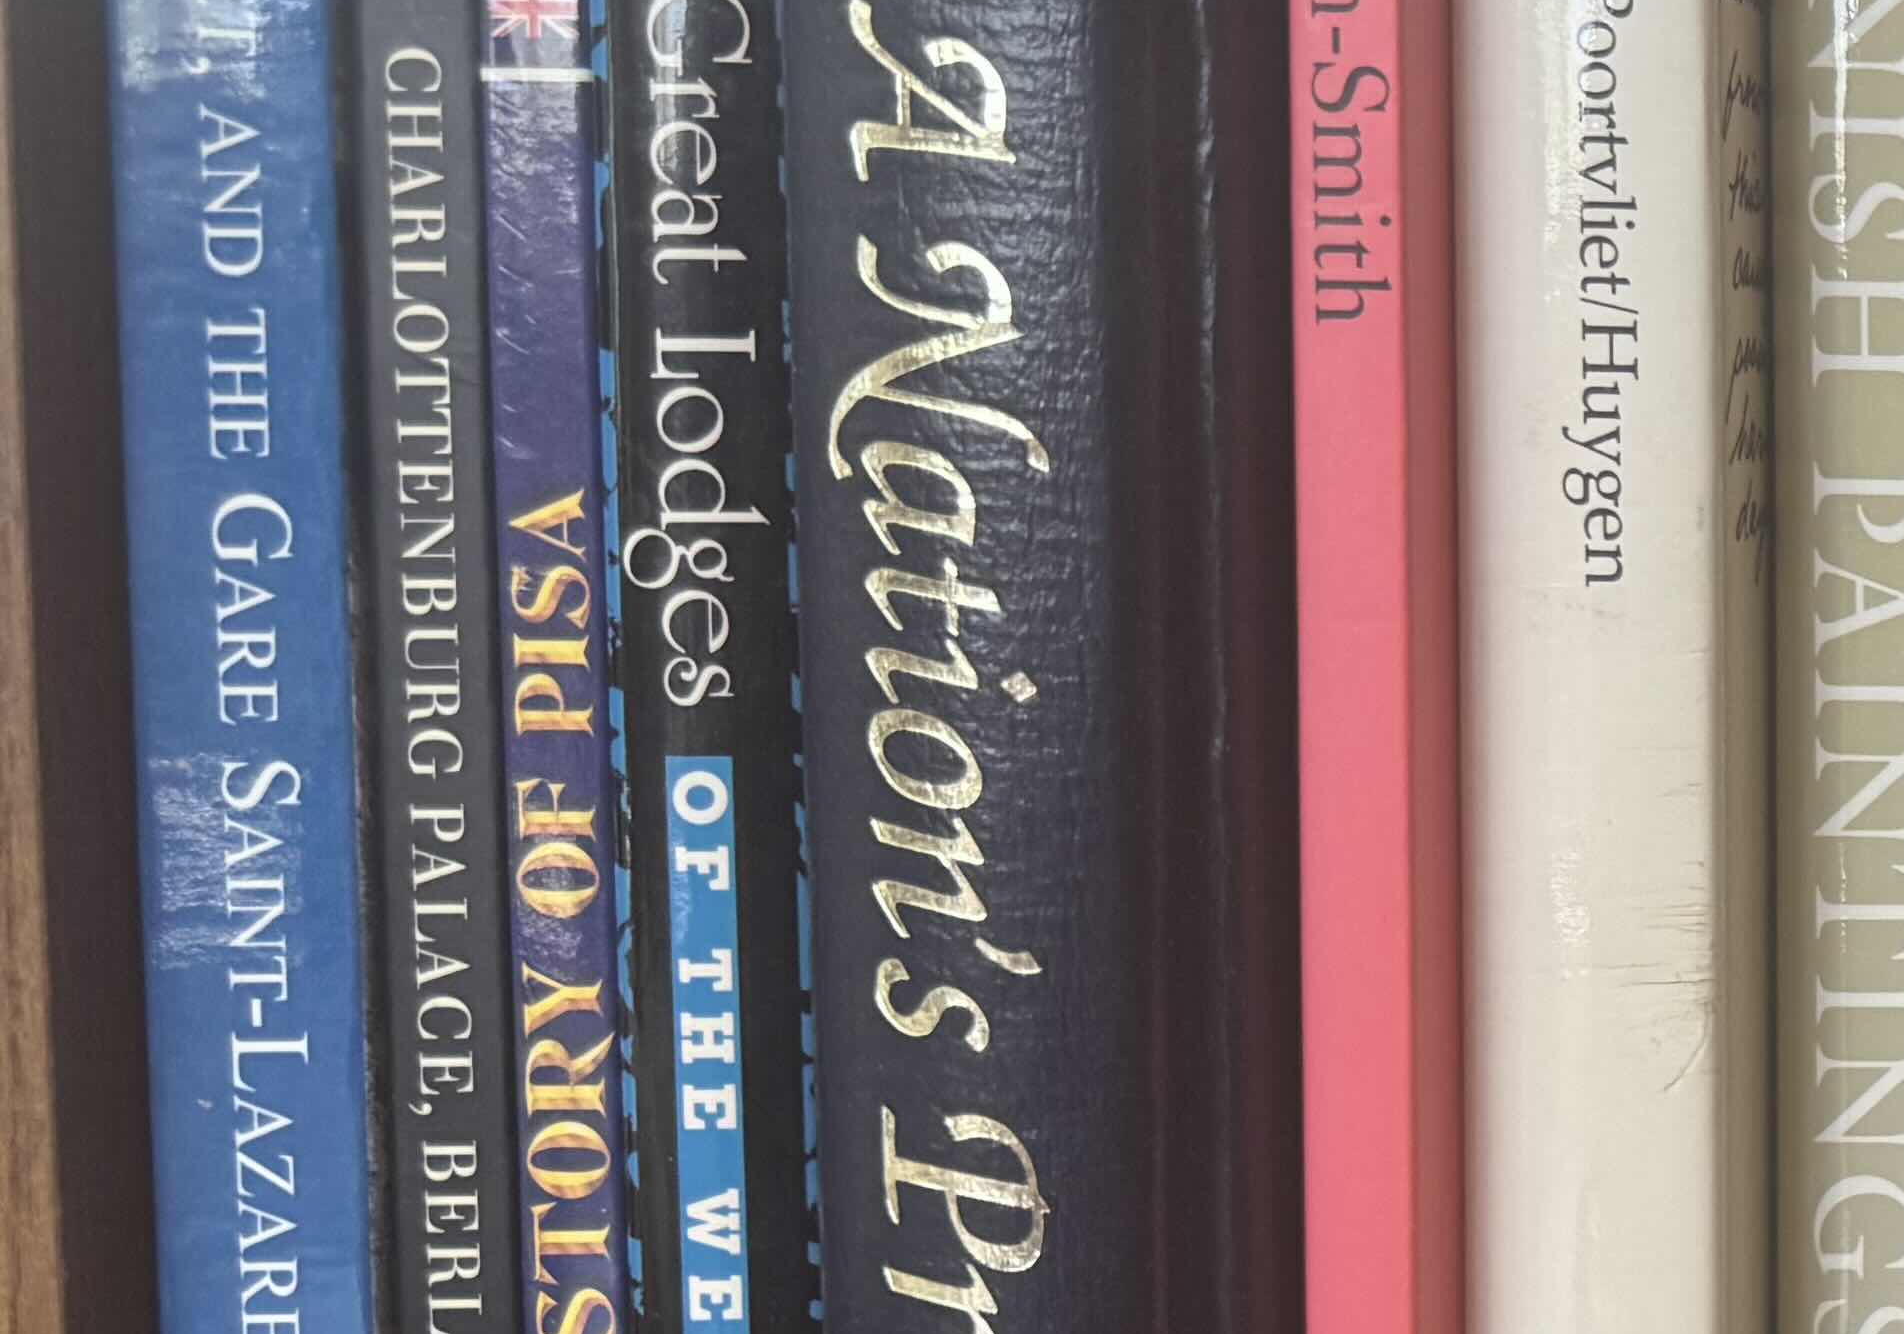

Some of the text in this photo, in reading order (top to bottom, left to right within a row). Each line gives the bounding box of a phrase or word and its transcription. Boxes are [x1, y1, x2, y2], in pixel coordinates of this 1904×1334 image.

[198, 106, 265, 278] AND
[203, 307, 271, 462] THE
[383, 46, 465, 781] CHARLOTTENBURG
[211, 491, 294, 726] GARE
[508, 487, 597, 739] PISA
[623, 328, 771, 710] Lodges
[828, 234, 1050, 1057] Nation's
[515, 776, 601, 921] OF
[672, 768, 732, 893] OF
[408, 802, 475, 1117] PALACE,
[675, 949, 738, 1132] THE
